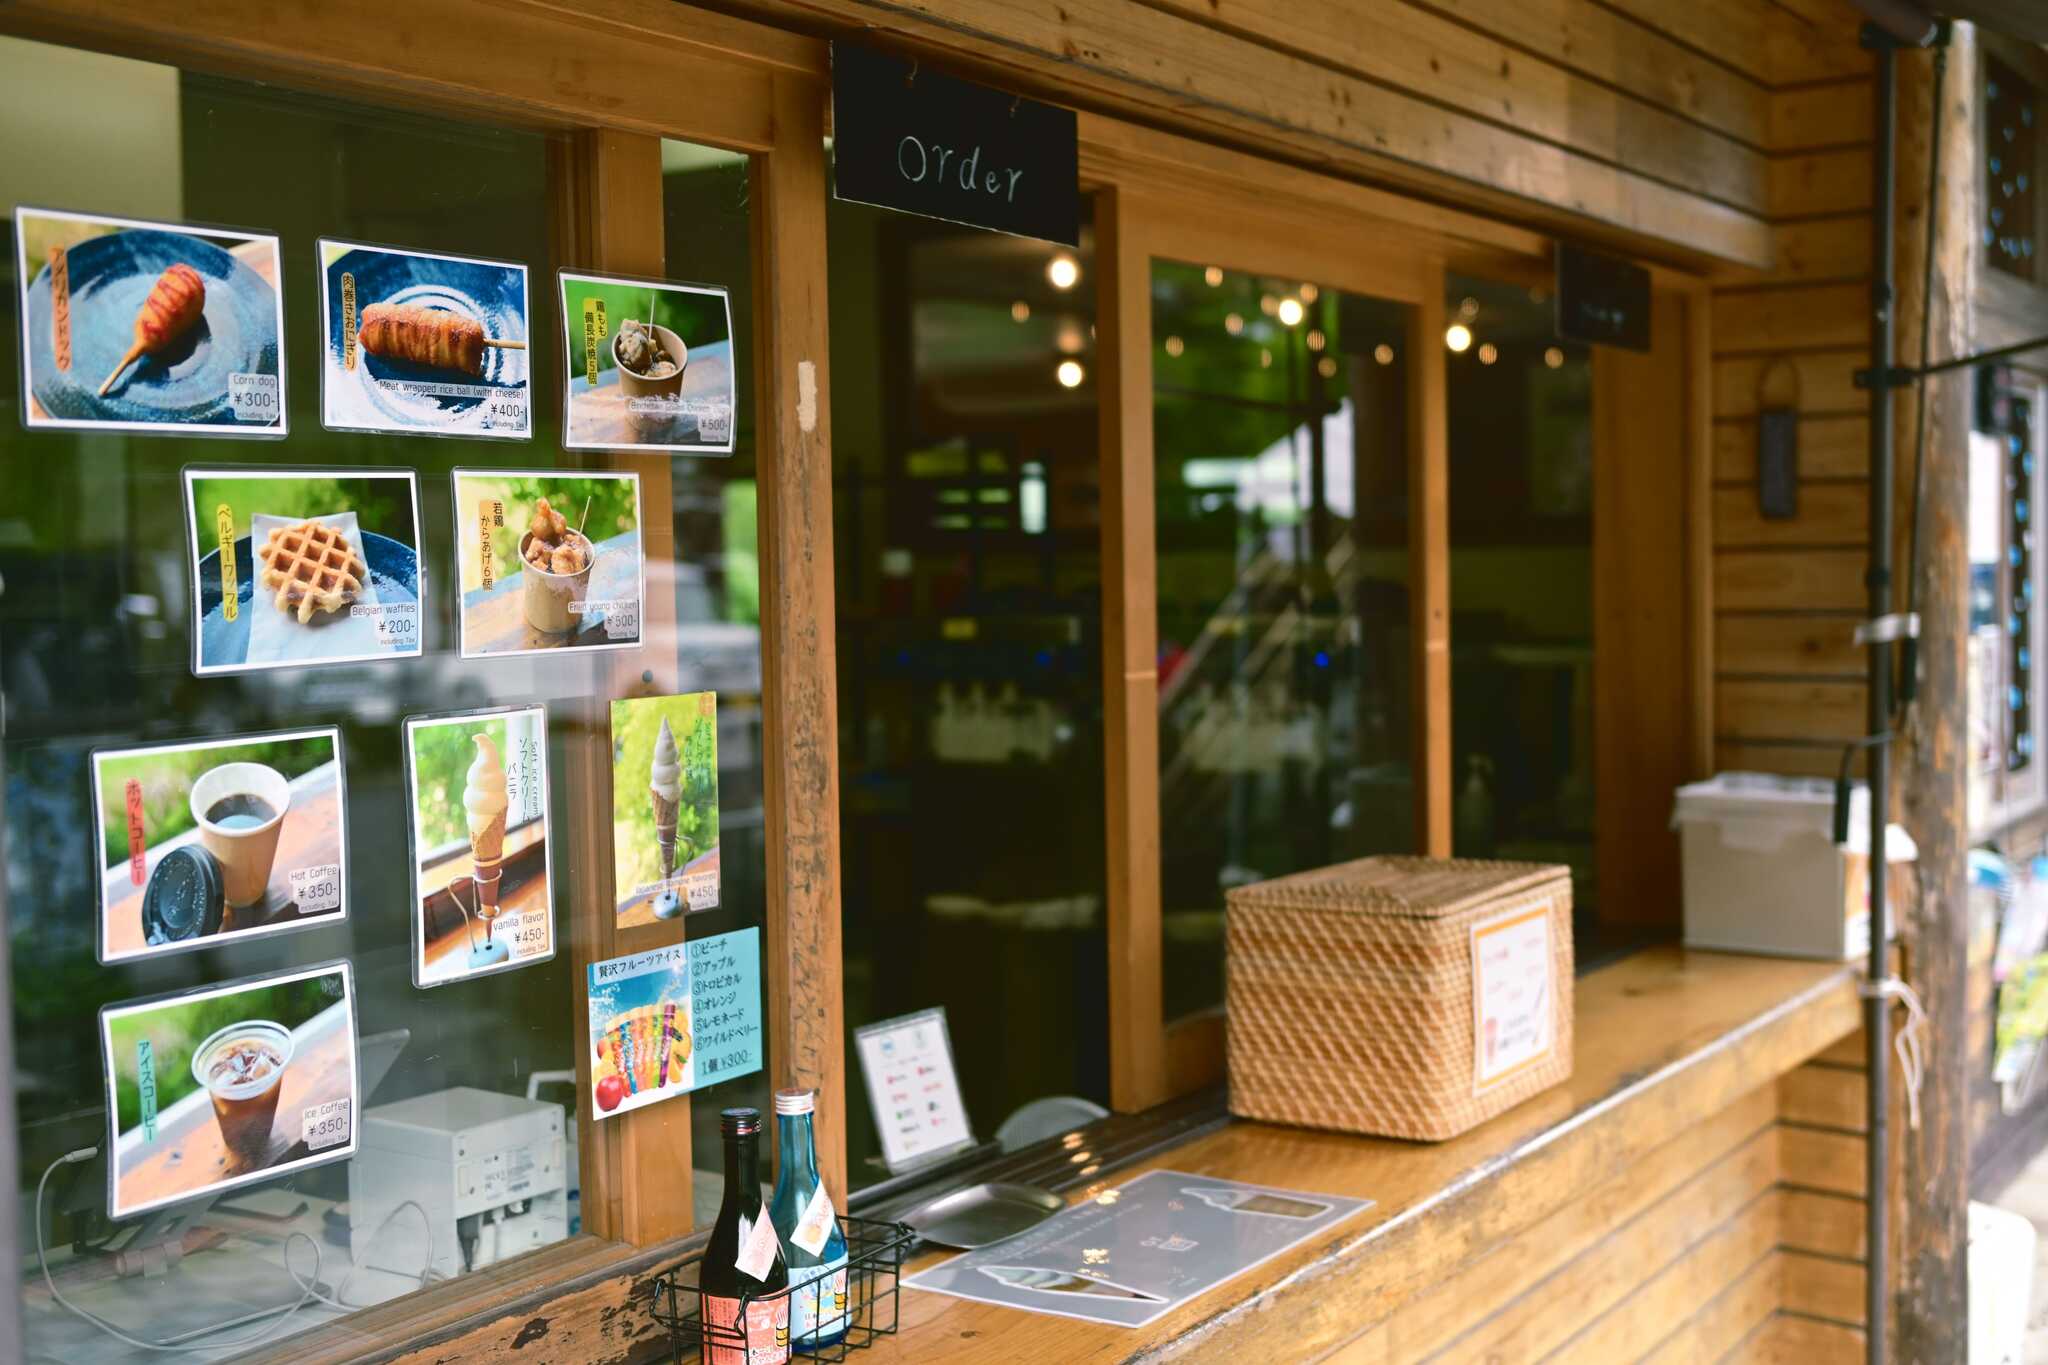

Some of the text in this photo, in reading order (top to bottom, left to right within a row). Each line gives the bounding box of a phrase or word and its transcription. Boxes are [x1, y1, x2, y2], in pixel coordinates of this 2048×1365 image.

[898, 135, 1023, 203] Order
[233, 374, 275, 388] Corn dog
[379, 380, 525, 400] Meat wrapped rice ball (with cheese)
[218, 507, 238, 619] ベルギーワッフル
[352, 603, 416, 618] Belgian waffles
[519, 736, 530, 823] ソフトクリーム
[127, 782, 143, 882] ホットコーヒー
[290, 865, 337, 881] Hot Coffee
[599, 948, 681, 978] 贅沢フルーツアイス
[138, 1041, 155, 1141] アイスコーヒー
[320, 1100, 348, 1115] Coffee
